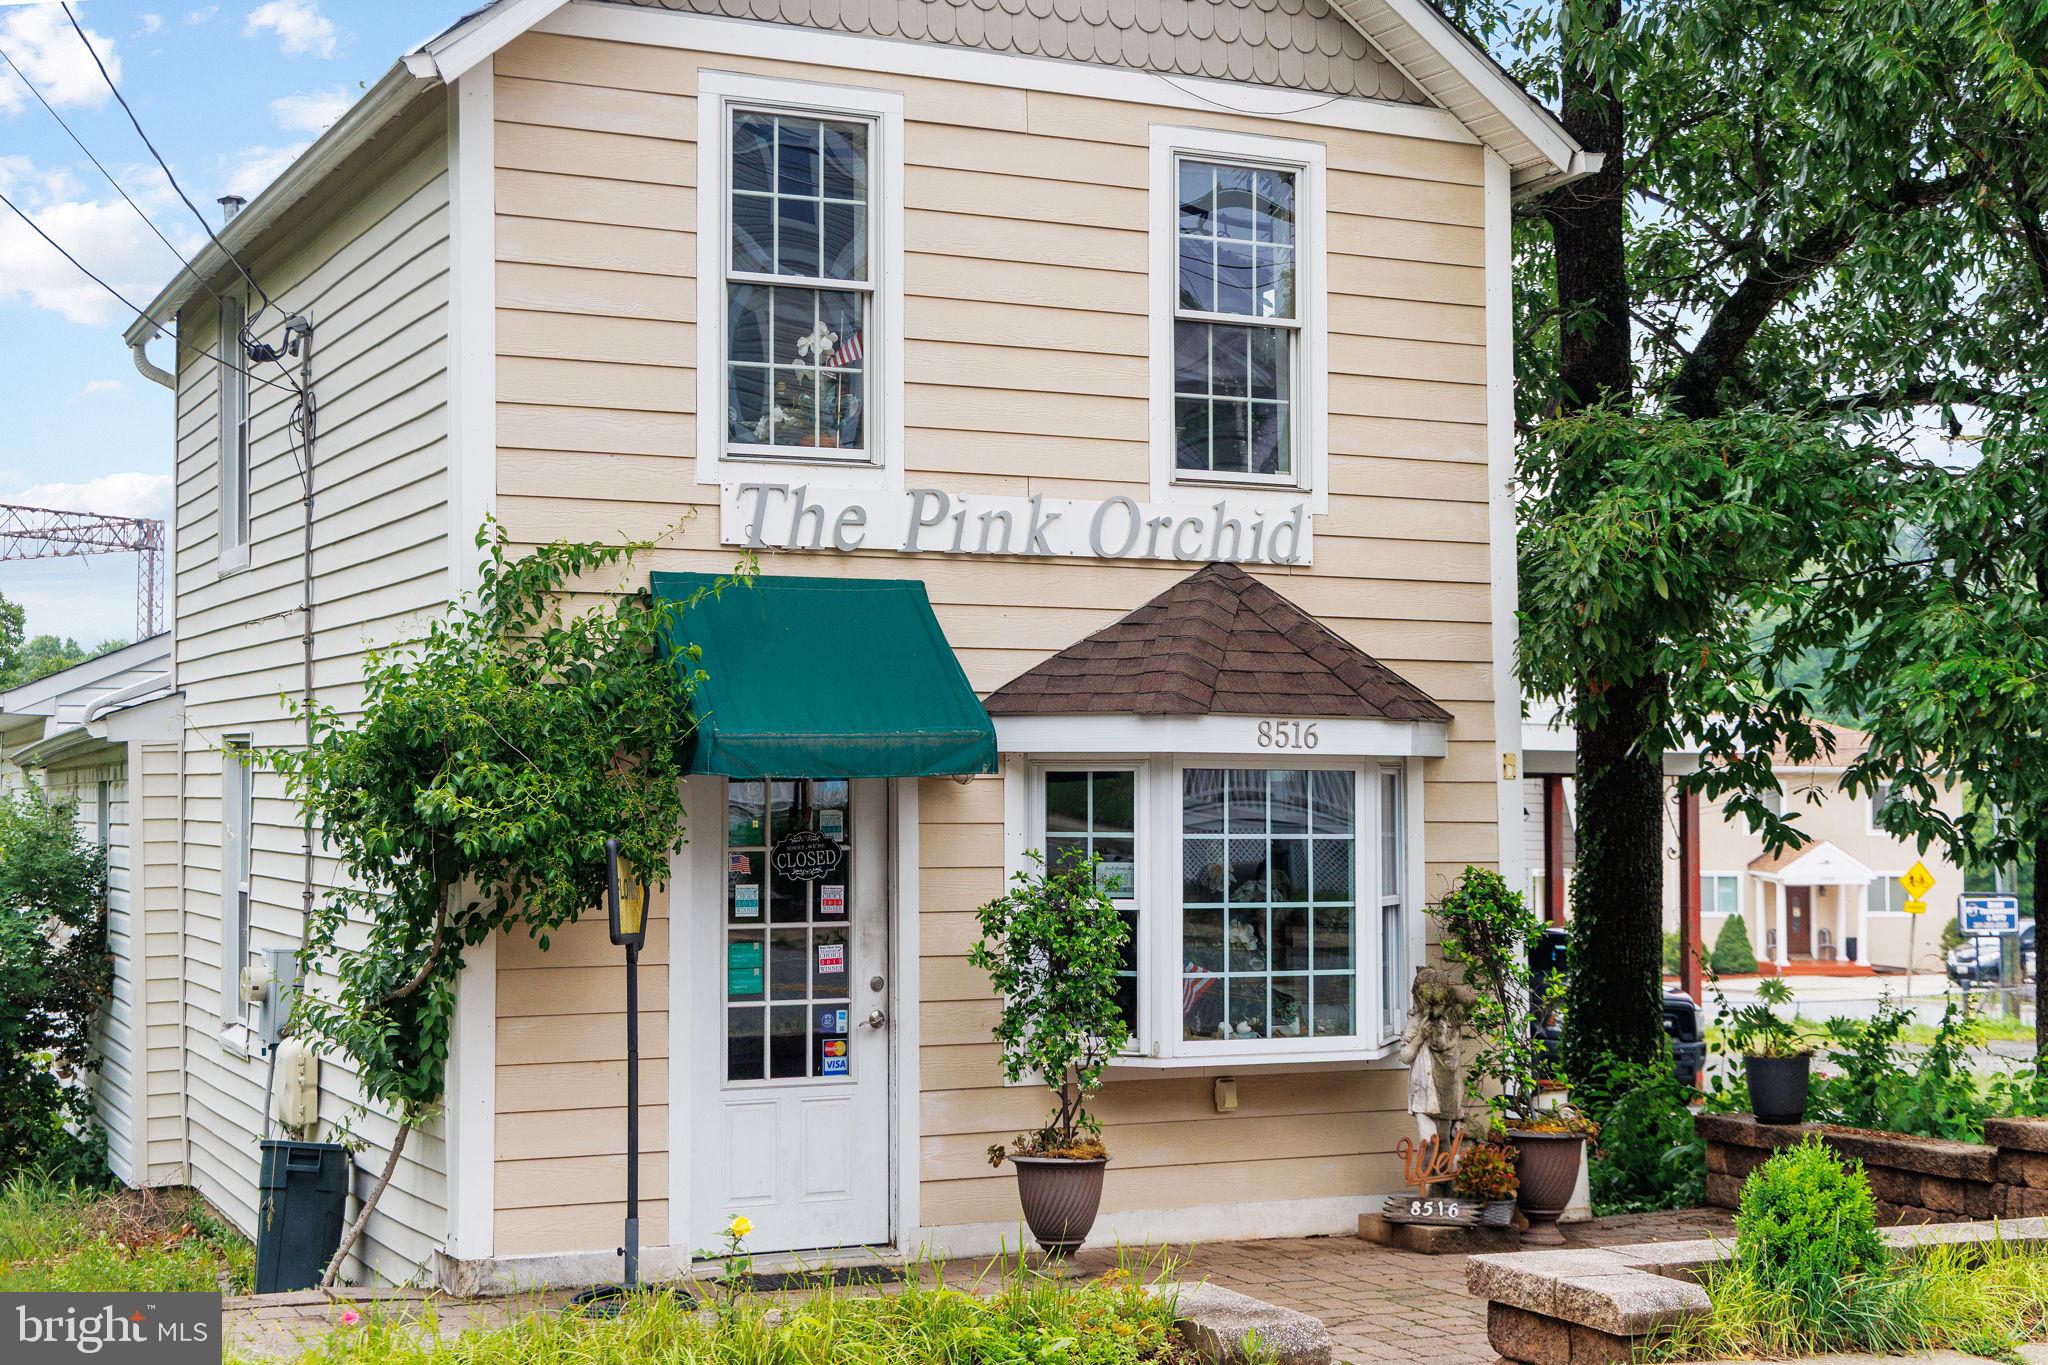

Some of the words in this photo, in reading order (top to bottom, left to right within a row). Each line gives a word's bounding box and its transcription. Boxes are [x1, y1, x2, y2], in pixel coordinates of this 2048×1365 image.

[736, 482, 867, 552] The
[897, 488, 1062, 556] Pink
[1089, 495, 1304, 564] Orchid
[1257, 720, 1319, 749] 8516
[777, 849, 836, 869] CLOSED
[827, 1060, 846, 1069] VISA
[1410, 1200, 1459, 1218] 8516
